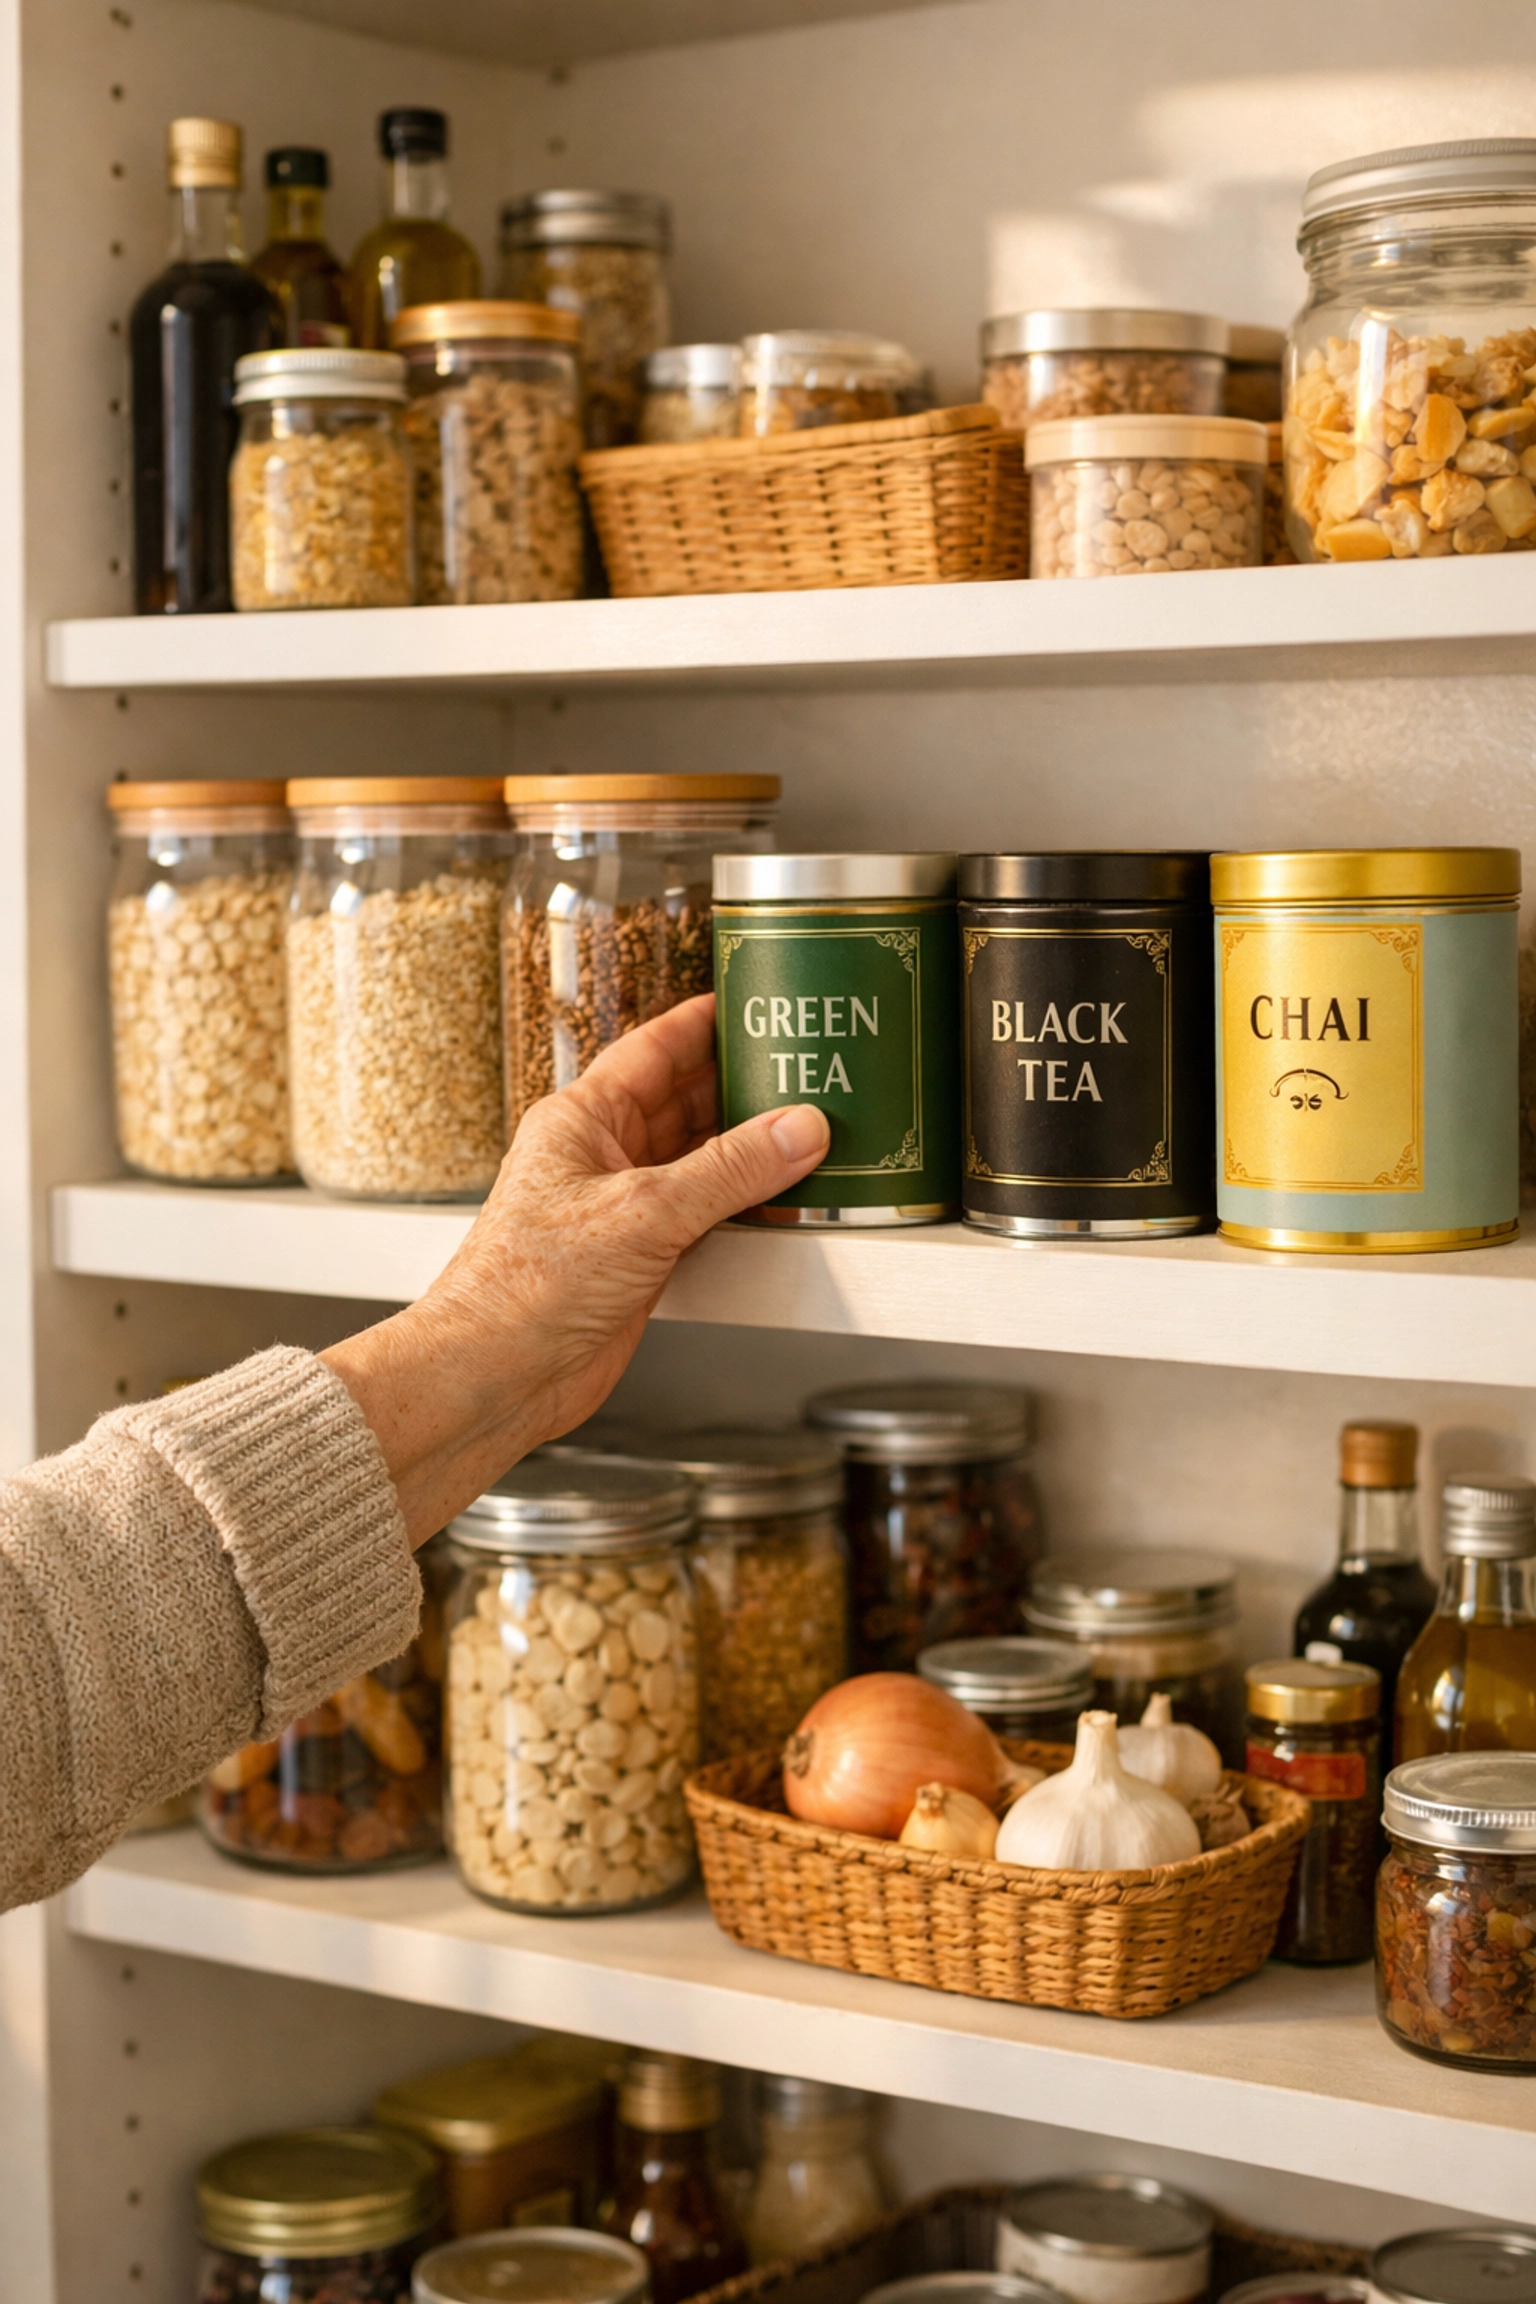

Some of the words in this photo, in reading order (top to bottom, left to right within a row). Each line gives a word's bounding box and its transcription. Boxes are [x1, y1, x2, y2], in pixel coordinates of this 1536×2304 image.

[743, 996, 879, 1038] GREEN
[992, 1000, 1128, 1043] BLACK
[1250, 994, 1371, 1042] CHAI
[769, 1052, 853, 1095] TEA
[1017, 1059, 1103, 1102] TEA
